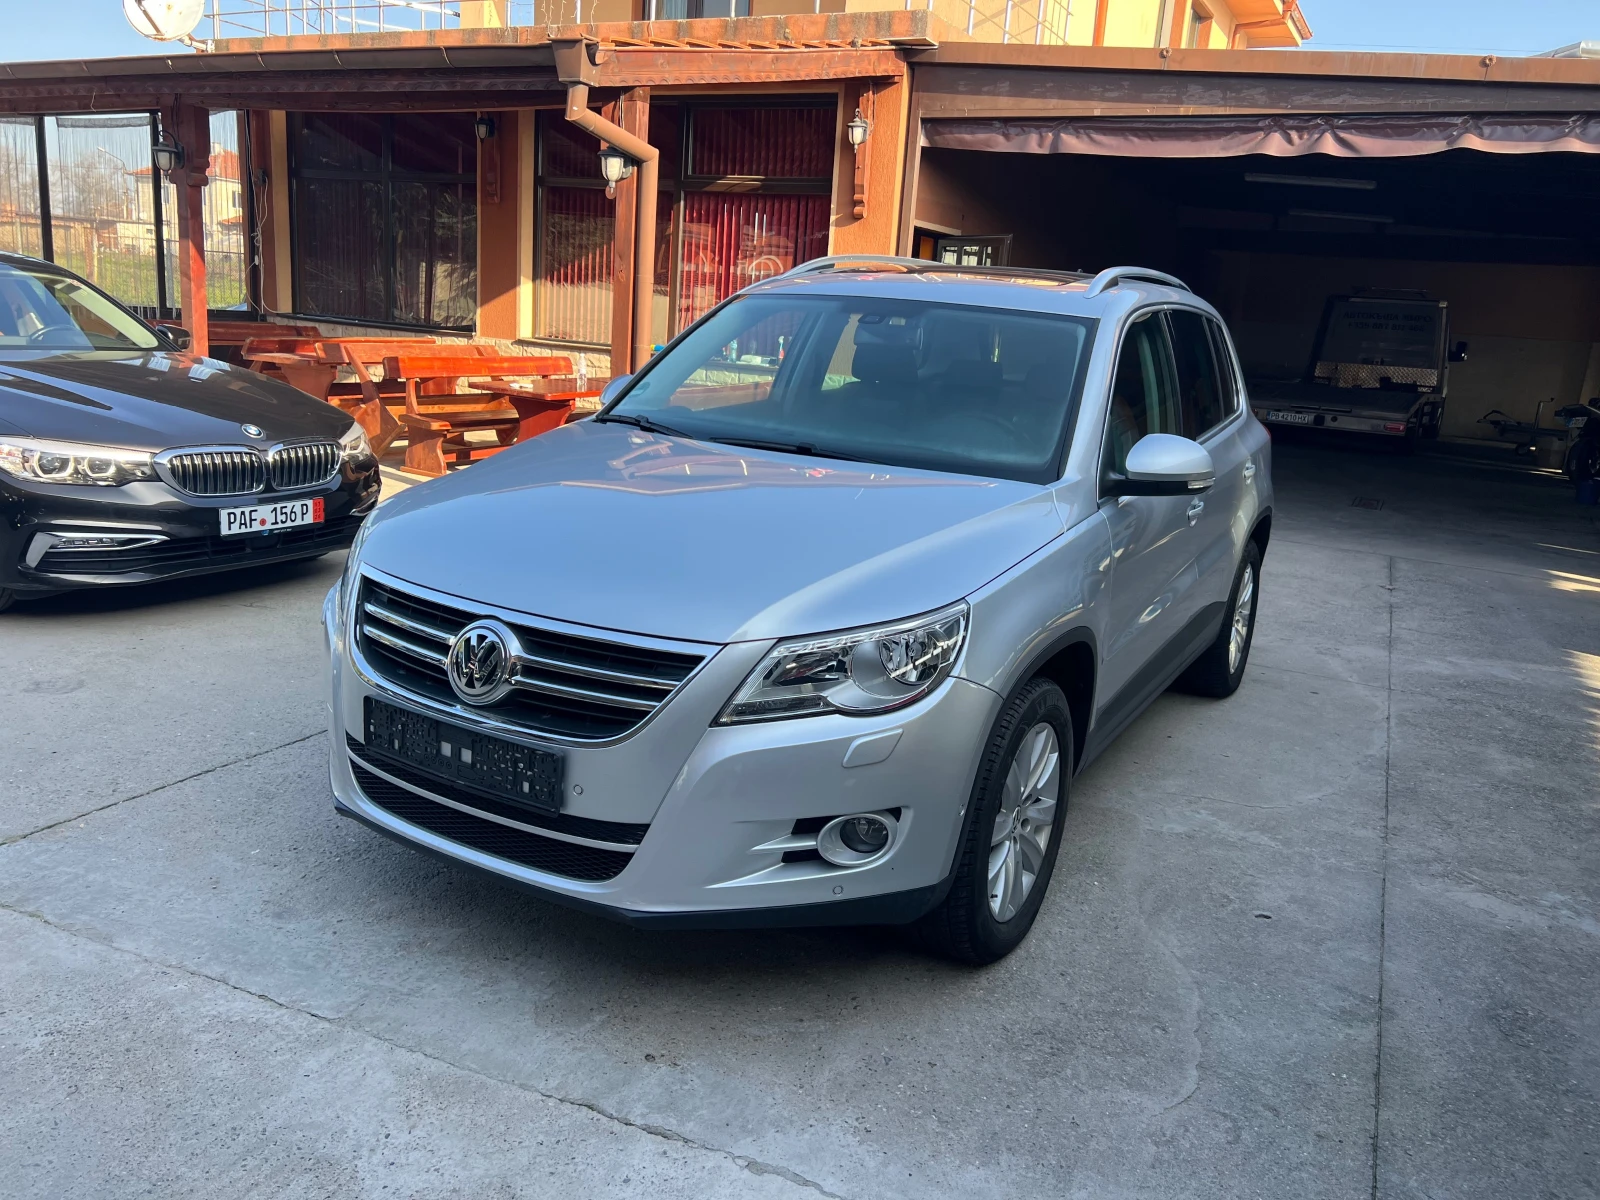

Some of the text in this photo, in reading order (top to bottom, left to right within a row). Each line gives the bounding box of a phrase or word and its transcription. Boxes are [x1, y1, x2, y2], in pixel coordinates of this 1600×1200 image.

[1280, 413, 1297, 422] 4210
[1297, 414, 1308, 422] HX
[227, 503, 309, 531] PAF 156 P
